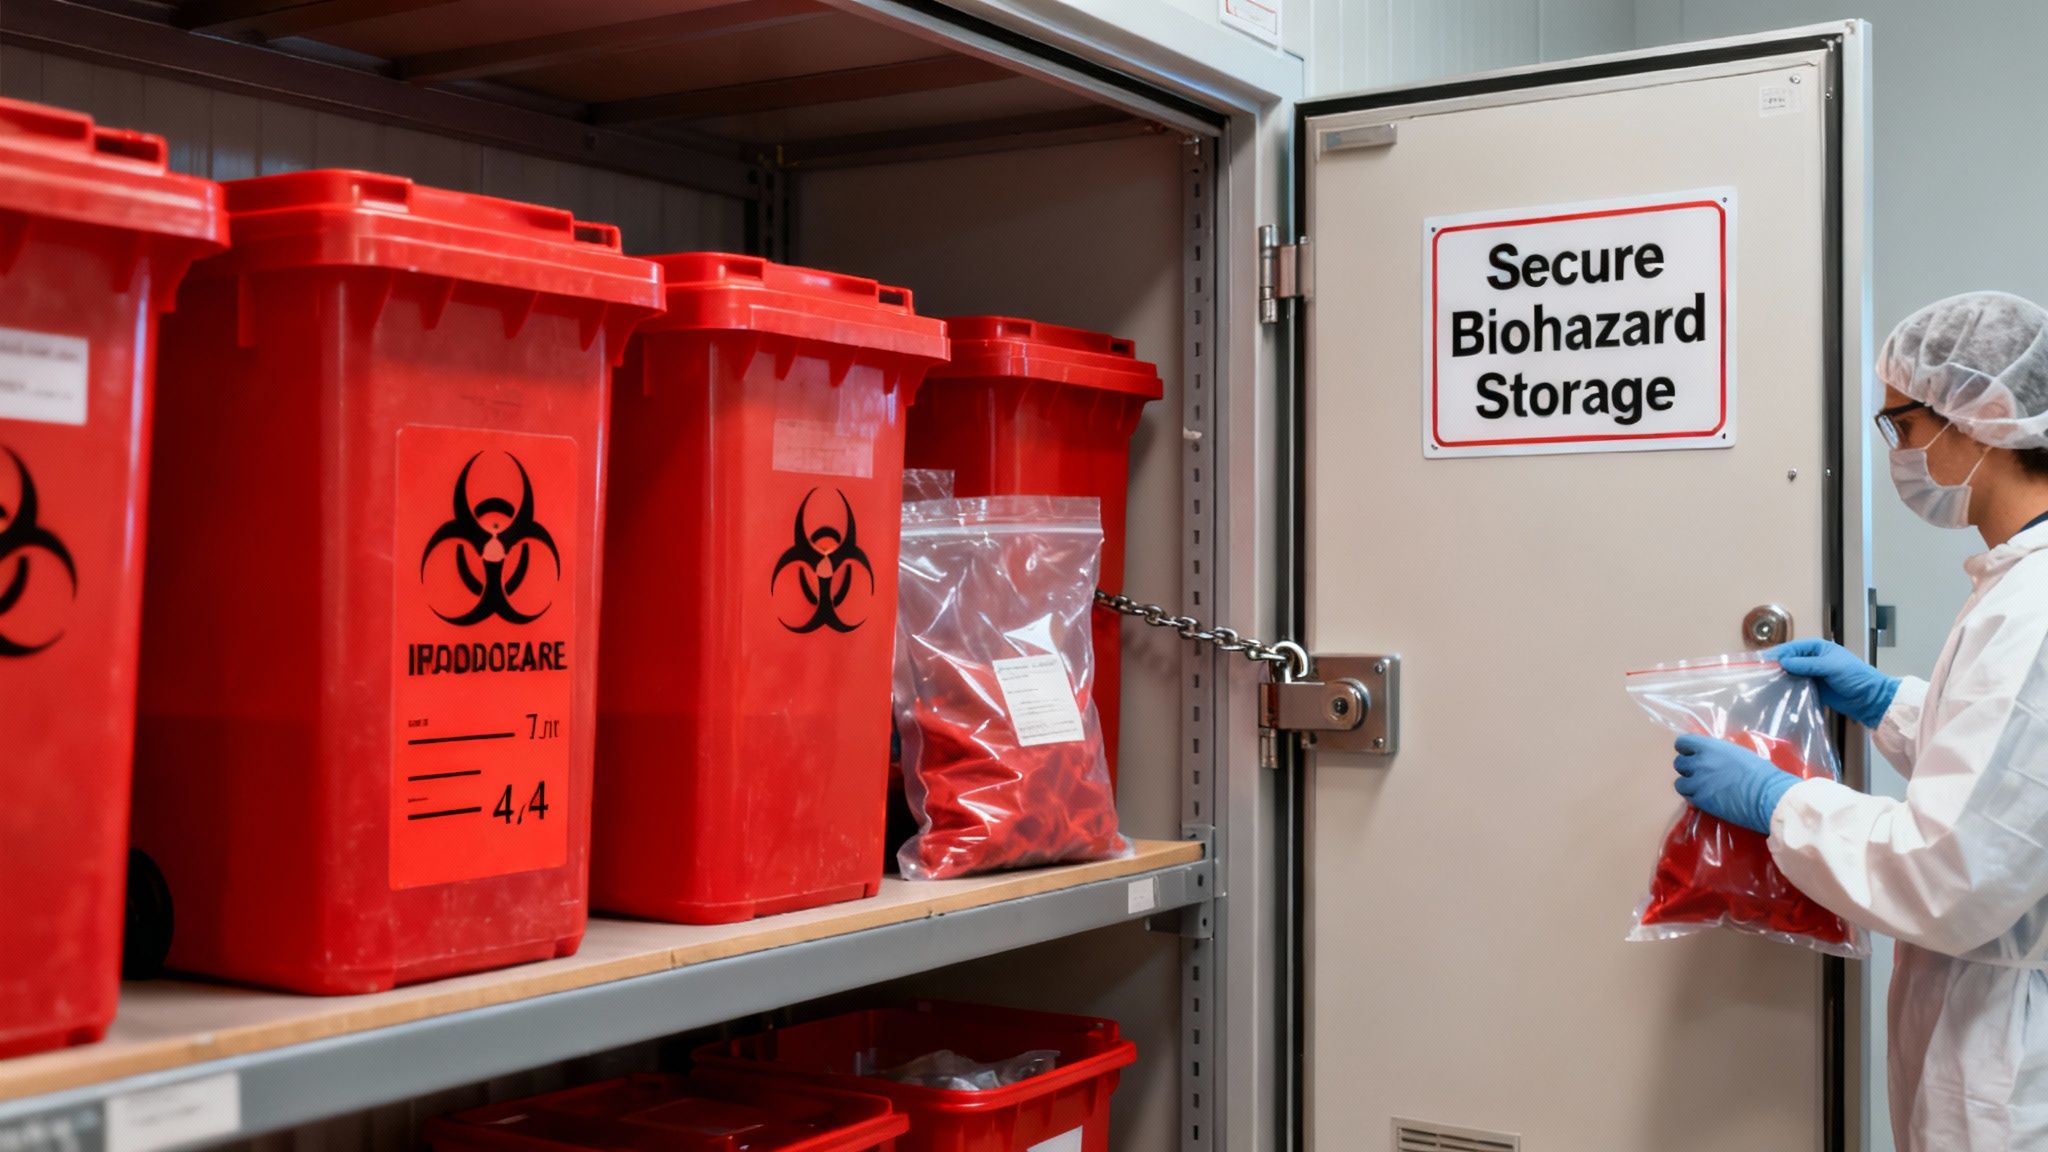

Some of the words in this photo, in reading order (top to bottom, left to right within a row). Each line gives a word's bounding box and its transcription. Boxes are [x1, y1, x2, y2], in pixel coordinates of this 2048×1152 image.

[1487, 242, 1665, 290] Secure
[1452, 293, 1706, 357] Biohazard
[1476, 371, 1676, 426] Storage
